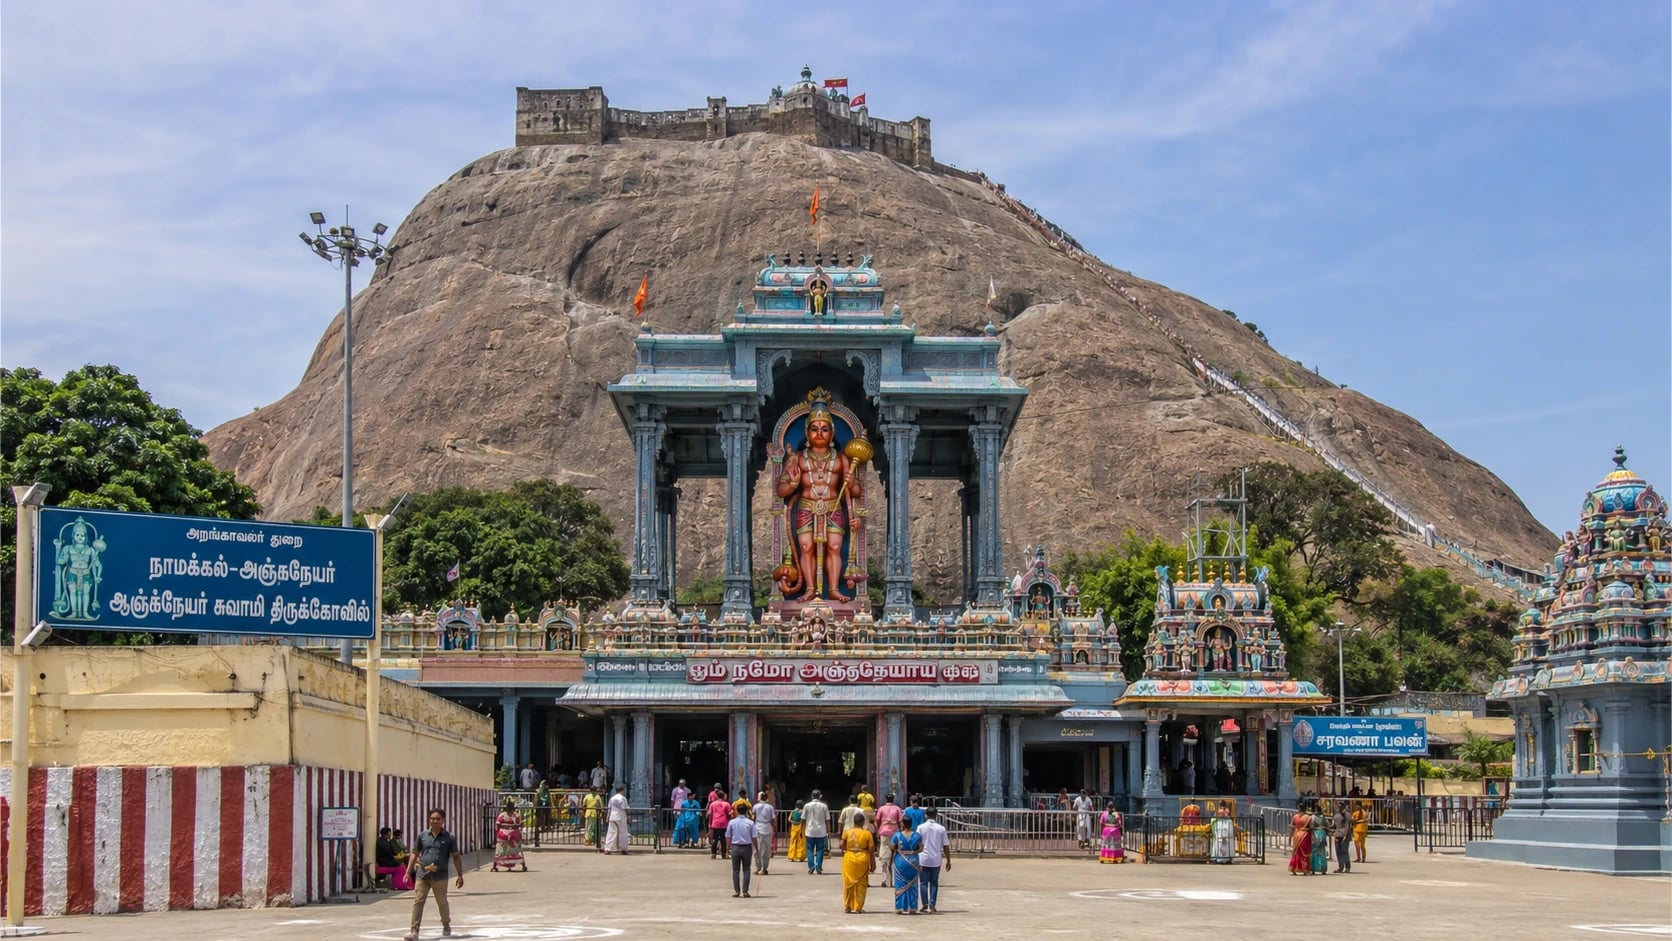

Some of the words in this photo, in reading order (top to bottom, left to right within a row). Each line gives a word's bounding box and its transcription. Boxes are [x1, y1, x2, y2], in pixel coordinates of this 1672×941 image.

[270, 534, 303, 549] துறை
[213, 594, 265, 617] சுவாமி
[270, 594, 370, 625] திருக்கோவில்
[731, 660, 794, 683] நமோ
